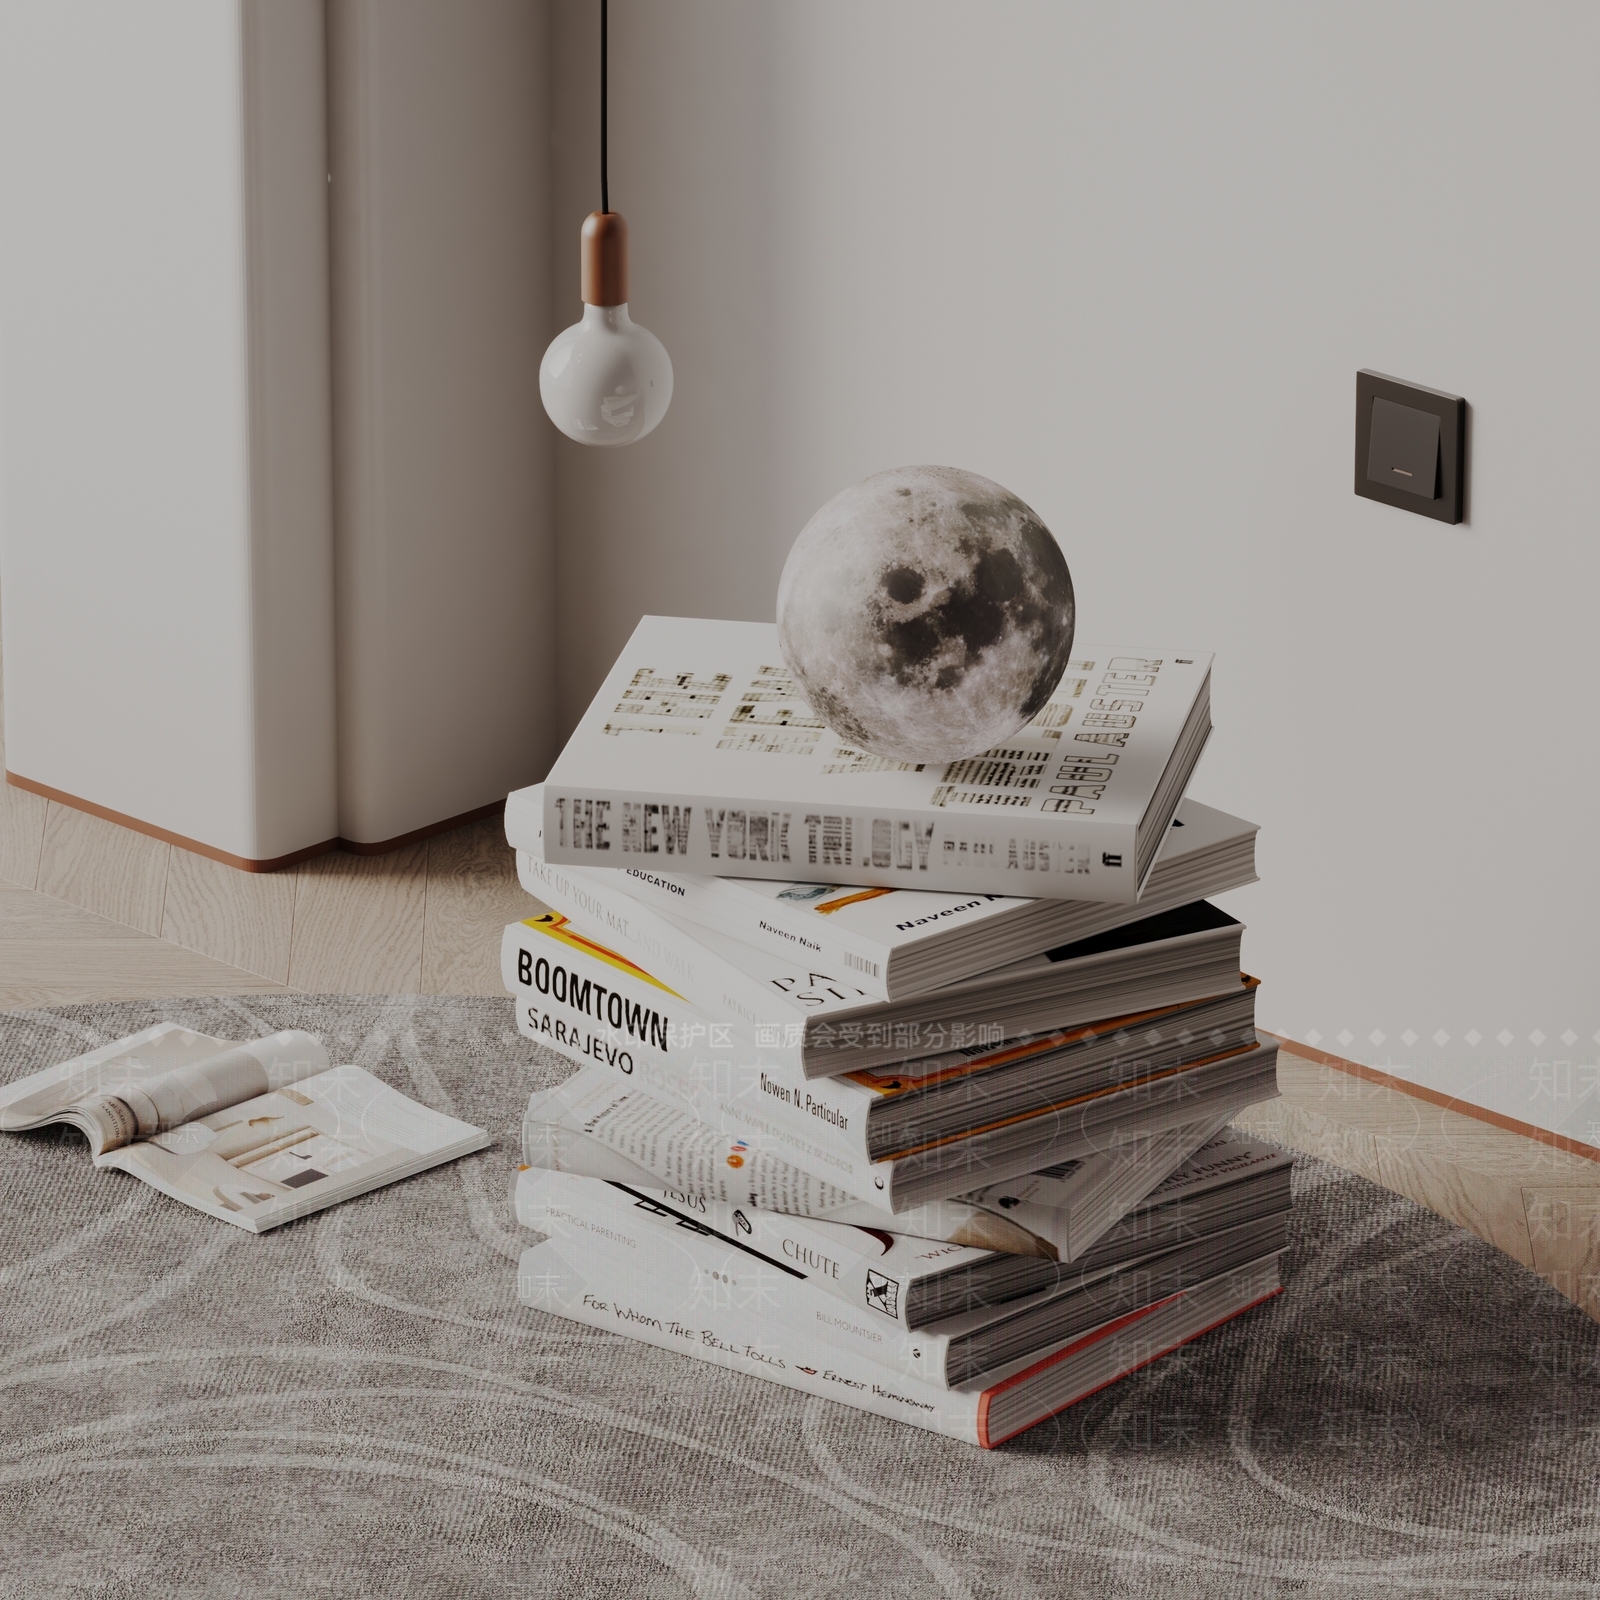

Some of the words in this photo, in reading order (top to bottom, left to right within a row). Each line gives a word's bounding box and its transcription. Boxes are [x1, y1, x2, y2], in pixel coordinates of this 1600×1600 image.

[601, 667, 734, 737] THE
[1073, 656, 1164, 748] AUSTER
[1040, 753, 1120, 815] PAUL
[555, 797, 611, 850] THE
[621, 802, 692, 855] NEW
[703, 808, 792, 863] YORK
[626, 868, 687, 897] EDUCATION
[527, 854, 553, 888] TAKE
[555, 873, 570, 897] UP
[572, 885, 604, 922] YOUR
[664, 946, 695, 983] WALK
[758, 920, 797, 943] Naveen
[798, 936, 823, 953] Naik
[895, 899, 982, 932] Naveen
[517, 947, 669, 1053] BOOMTOWN
[722, 993, 757, 1026] PATRICE
[528, 1007, 635, 1077] SARAJEVO
[760, 1071, 791, 1104] Nowen
[793, 1089, 804, 1111] N.
[806, 1093, 849, 1131] Particular
[1219, 1152, 1278, 1176] VIGILANTE
[545, 1206, 590, 1231] PRACTICAL
[591, 1224, 636, 1249] PARENTING
[782, 1239, 840, 1280] CHUTE
[582, 1293, 610, 1312] FOR
[612, 1302, 663, 1332] WHOM
[664, 1321, 696, 1341] THE
[700, 1329, 740, 1355] BELL
[742, 1344, 787, 1369] TOLLS
[822, 1369, 868, 1391] ERNEST
[816, 1310, 833, 1326] BILL
[834, 1318, 883, 1345] MOUNTSIER
